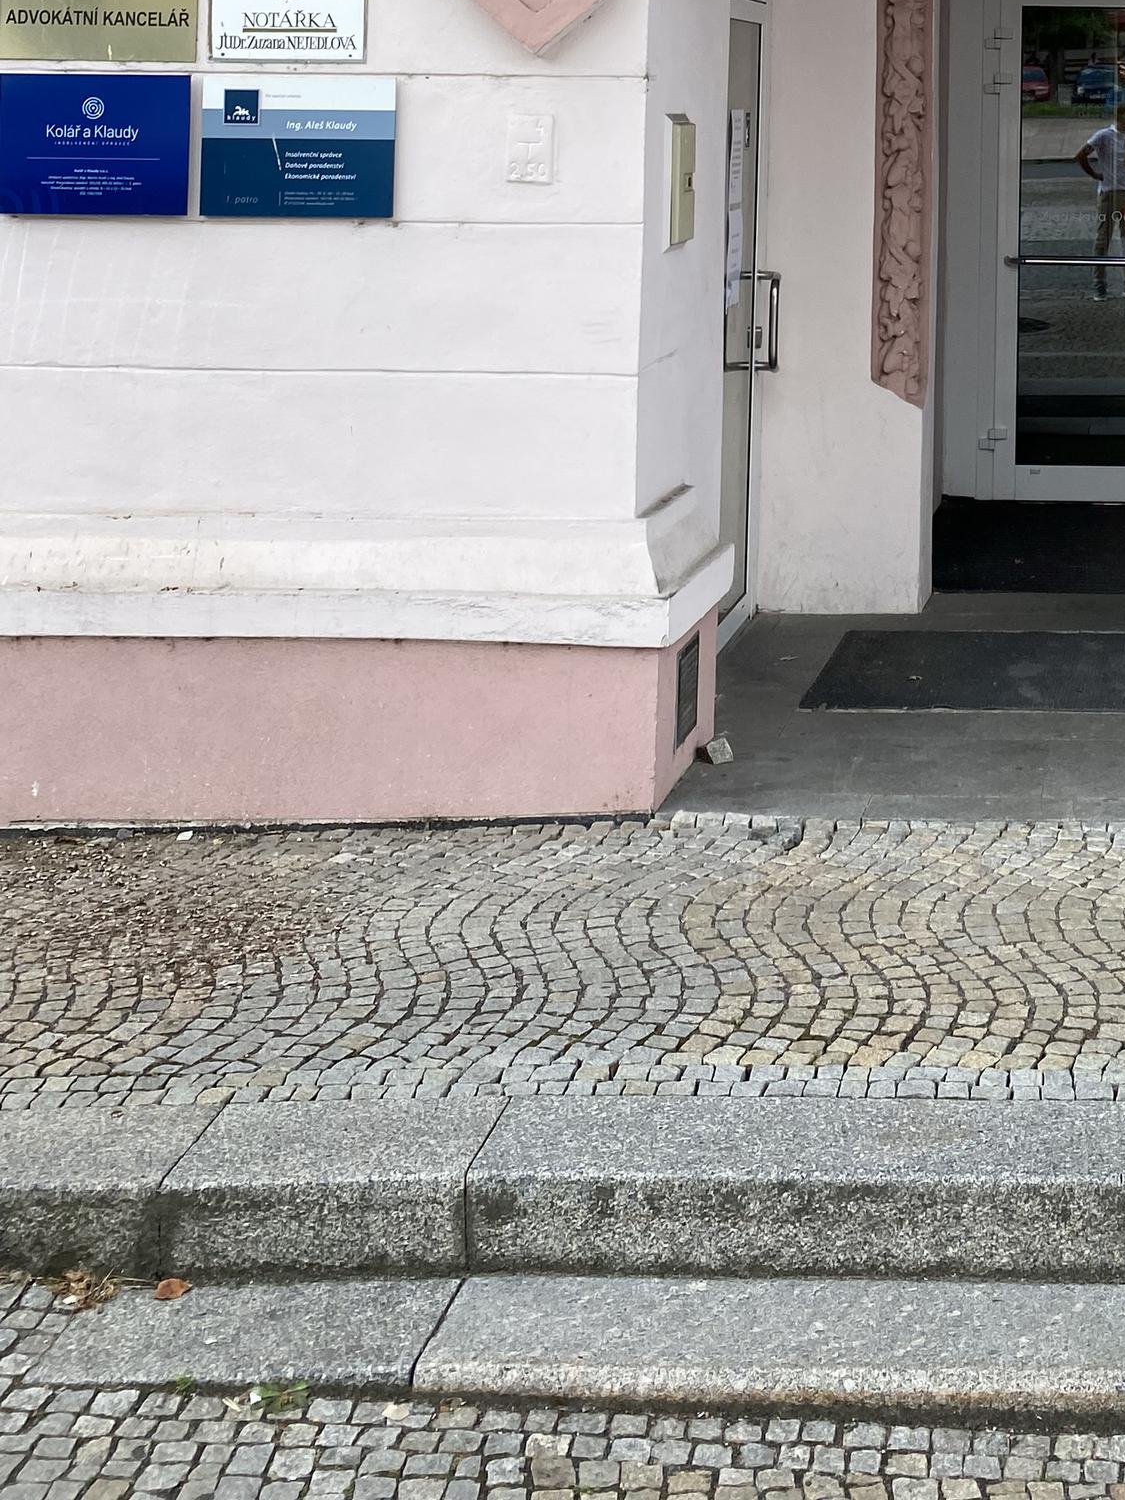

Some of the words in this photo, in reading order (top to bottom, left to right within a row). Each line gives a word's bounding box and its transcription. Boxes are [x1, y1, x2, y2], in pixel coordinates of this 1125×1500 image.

[6, 7, 98, 25] ADVOKÁTNÍ
[103, 8, 190, 27] KANCELÁŘ
[242, 10, 336, 28] NOTÁŘKA
[286, 34, 357, 50] NEJEDLOVÁ
[46, 124, 81, 138] Kolář
[83, 127, 91, 138] a
[94, 124, 139, 142] Klaudy
[286, 120, 303, 131] Ing.
[305, 120, 324, 129] Aleš
[325, 120, 357, 132] Klaudy
